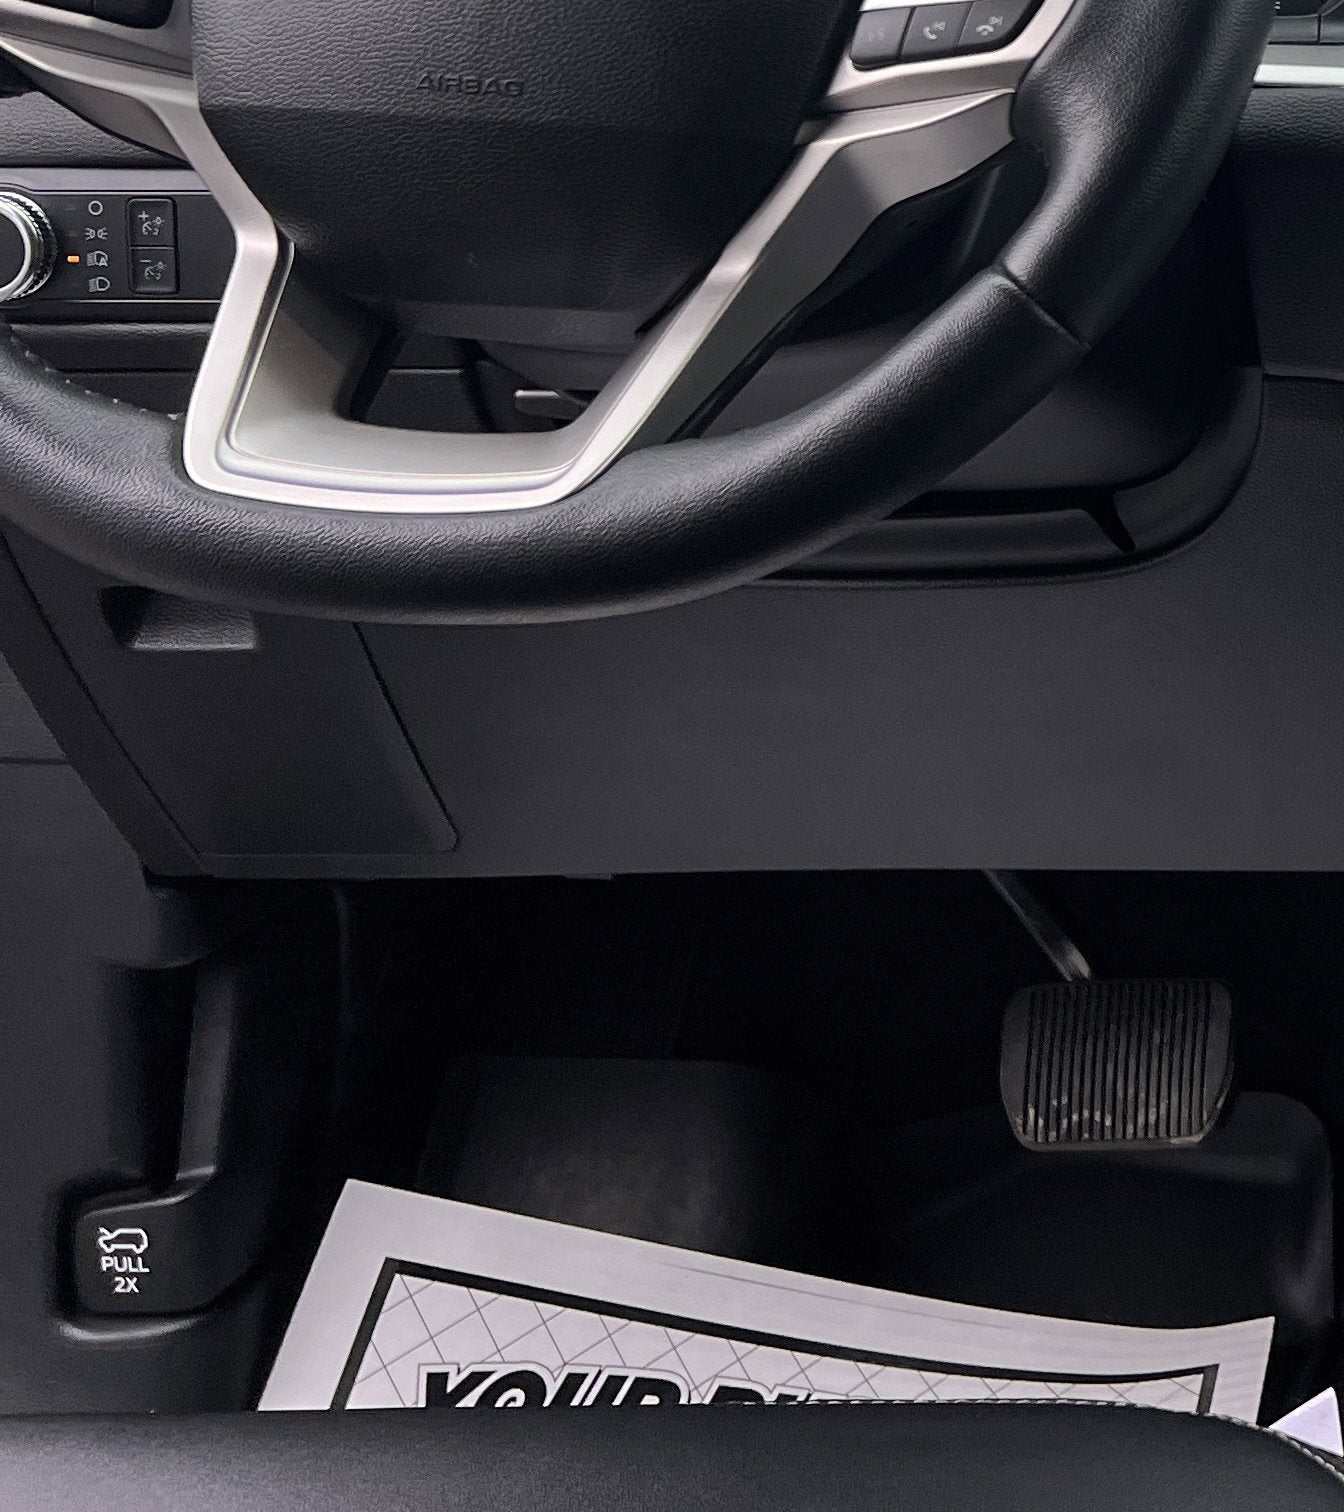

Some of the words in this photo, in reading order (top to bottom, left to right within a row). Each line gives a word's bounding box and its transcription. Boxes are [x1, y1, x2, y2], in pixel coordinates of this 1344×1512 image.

[415, 73, 525, 96] AIRBAG
[101, 1255, 150, 1273] PULL
[114, 1276, 140, 1294] 2X
